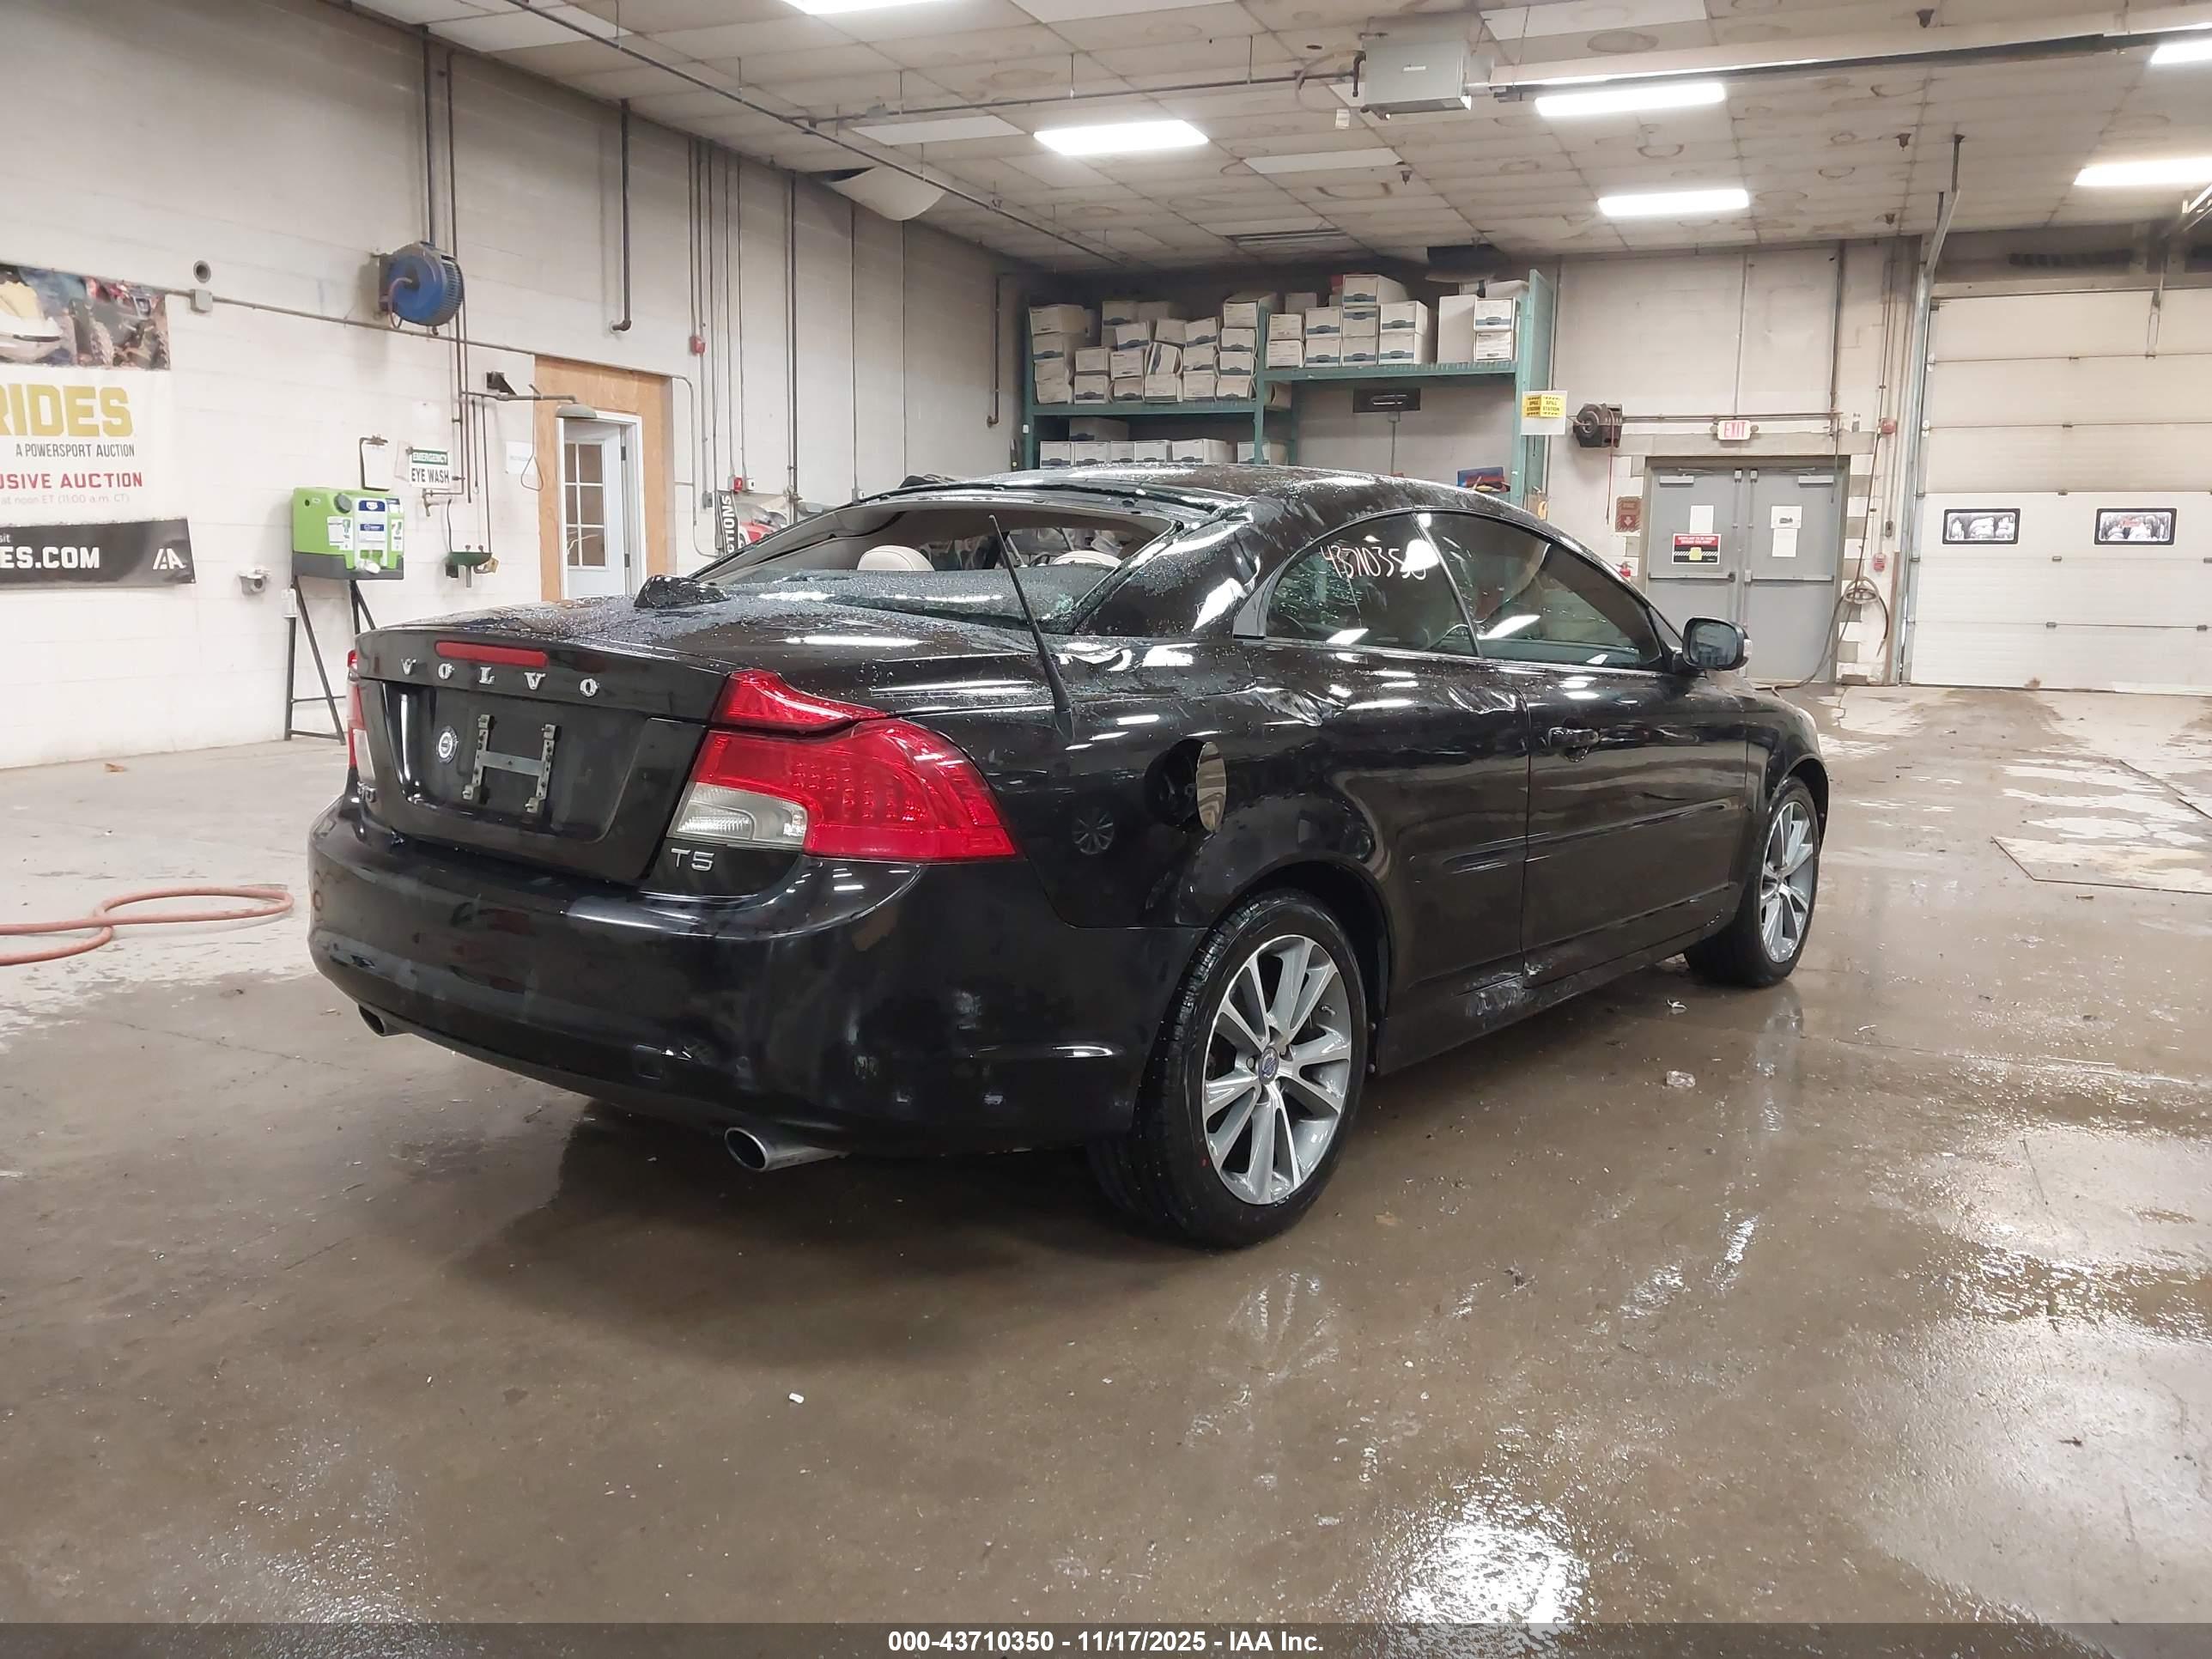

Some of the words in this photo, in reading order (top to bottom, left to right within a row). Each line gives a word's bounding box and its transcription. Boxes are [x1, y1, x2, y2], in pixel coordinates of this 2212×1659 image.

[1724, 422, 1746, 438] EXIT
[15, 443, 23, 458] A
[25, 443, 92, 458] POWERSPORT
[96, 443, 135, 458] AUCTION
[60, 471, 143, 488] AUCTION
[411, 467, 426, 483] EYE
[428, 468, 450, 483] WASH
[42, 495, 54, 504] ET
[401, 658, 599, 697] VOLVO
[671, 848, 714, 871] T5
